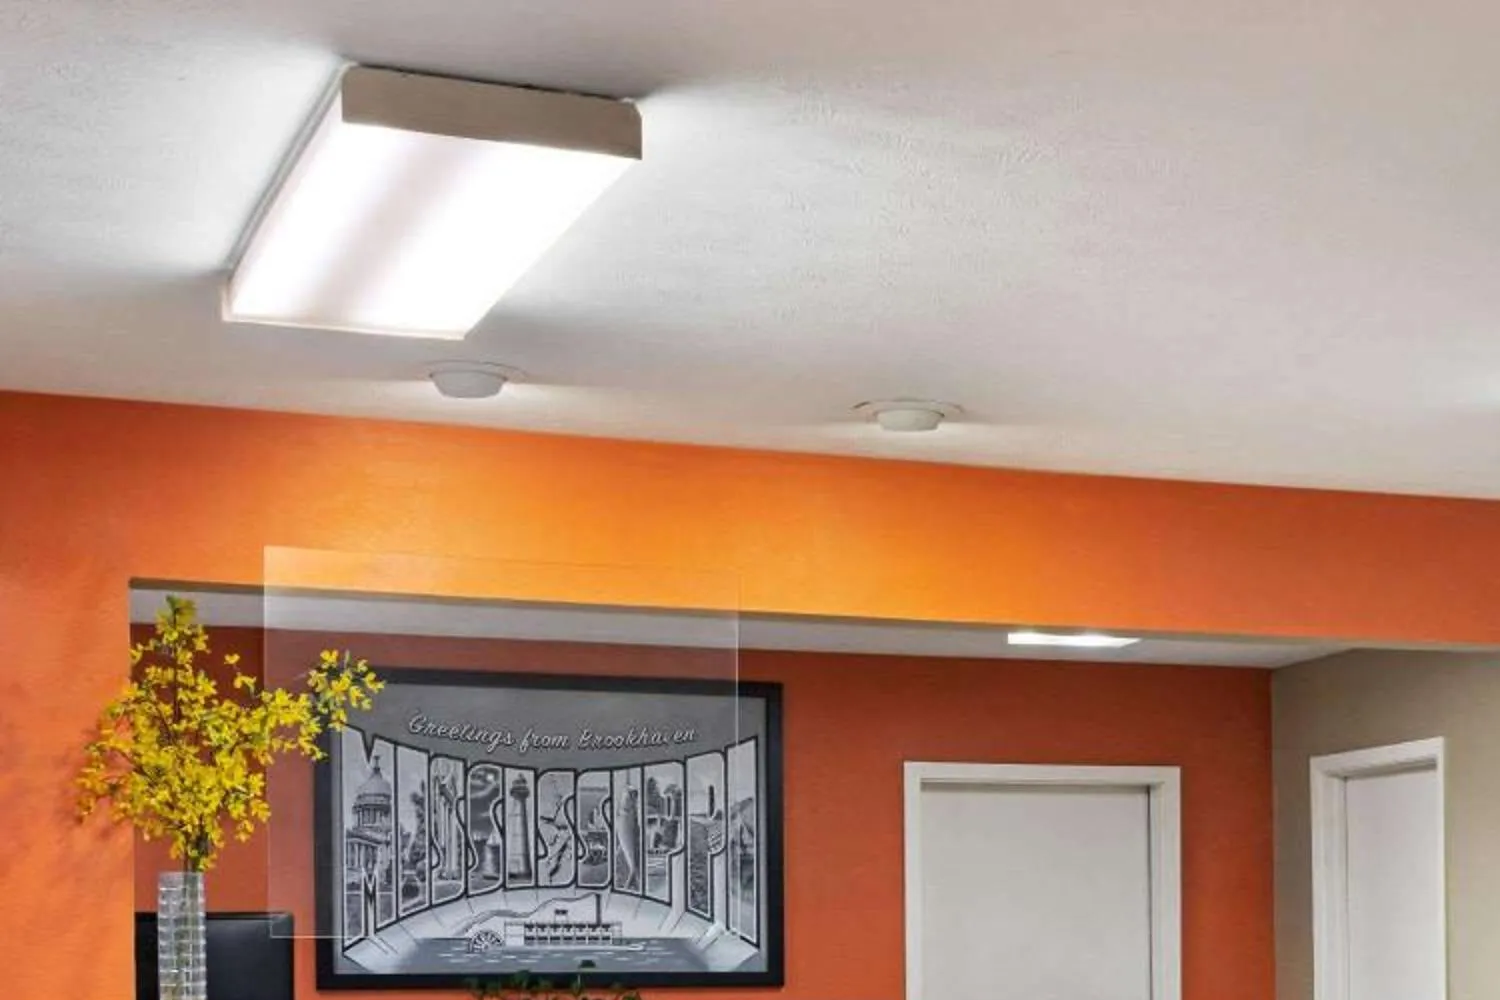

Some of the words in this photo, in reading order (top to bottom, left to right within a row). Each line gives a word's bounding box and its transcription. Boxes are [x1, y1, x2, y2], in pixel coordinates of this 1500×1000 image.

[408, 711, 514, 753] Greetings
[519, 728, 570, 753] from
[341, 722, 760, 953] MISSISSIPPI
